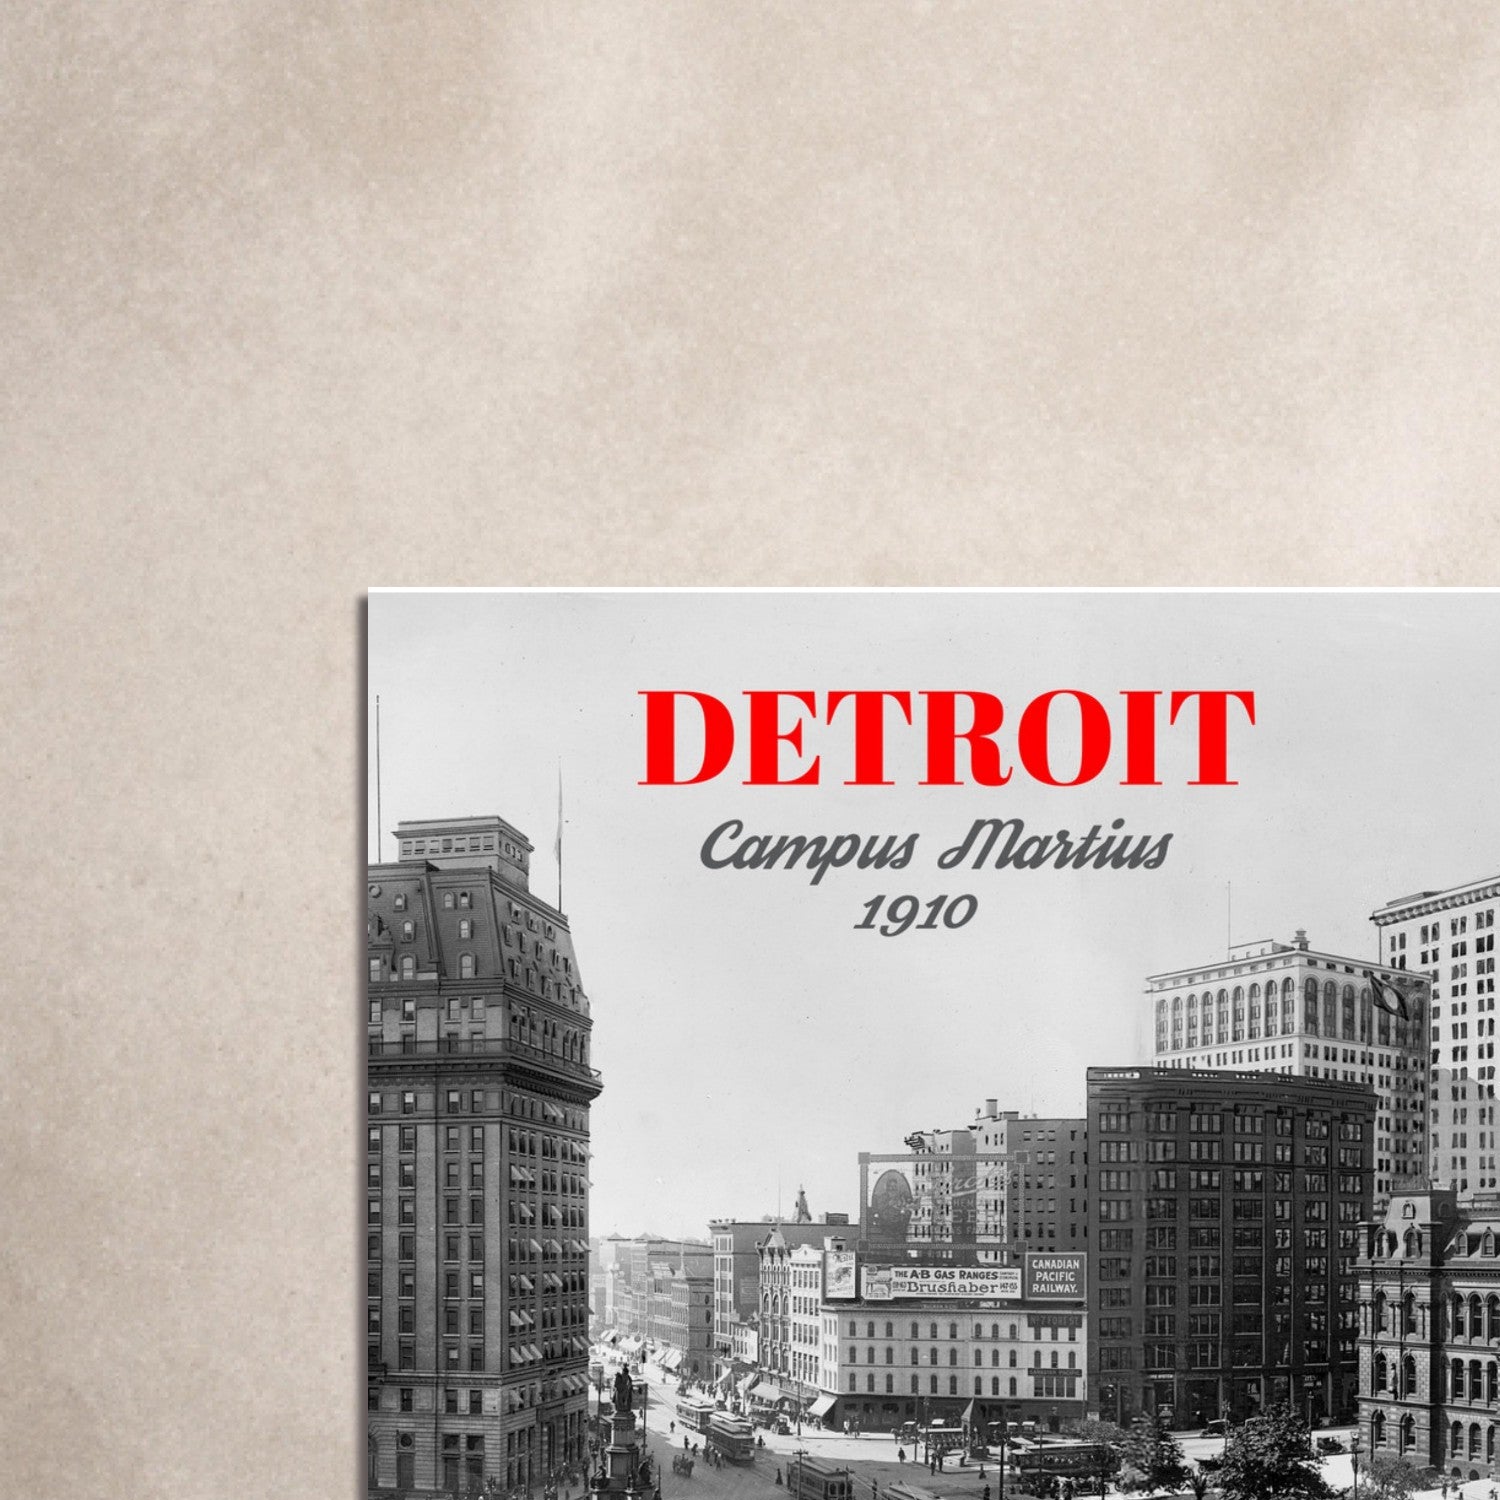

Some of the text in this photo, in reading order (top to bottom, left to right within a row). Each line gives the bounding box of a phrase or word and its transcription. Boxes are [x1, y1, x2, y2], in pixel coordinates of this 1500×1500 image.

[639, 690, 1255, 786] DETROIT
[701, 817, 1173, 886] Campus Martius
[854, 894, 978, 937] 1910
[894, 1270, 908, 1278] THE
[934, 1269, 955, 1280] GAS
[958, 1269, 998, 1280] RANGES
[1032, 1259, 1080, 1270] CANADIAN
[1035, 1271, 1076, 1282] PACIFIC
